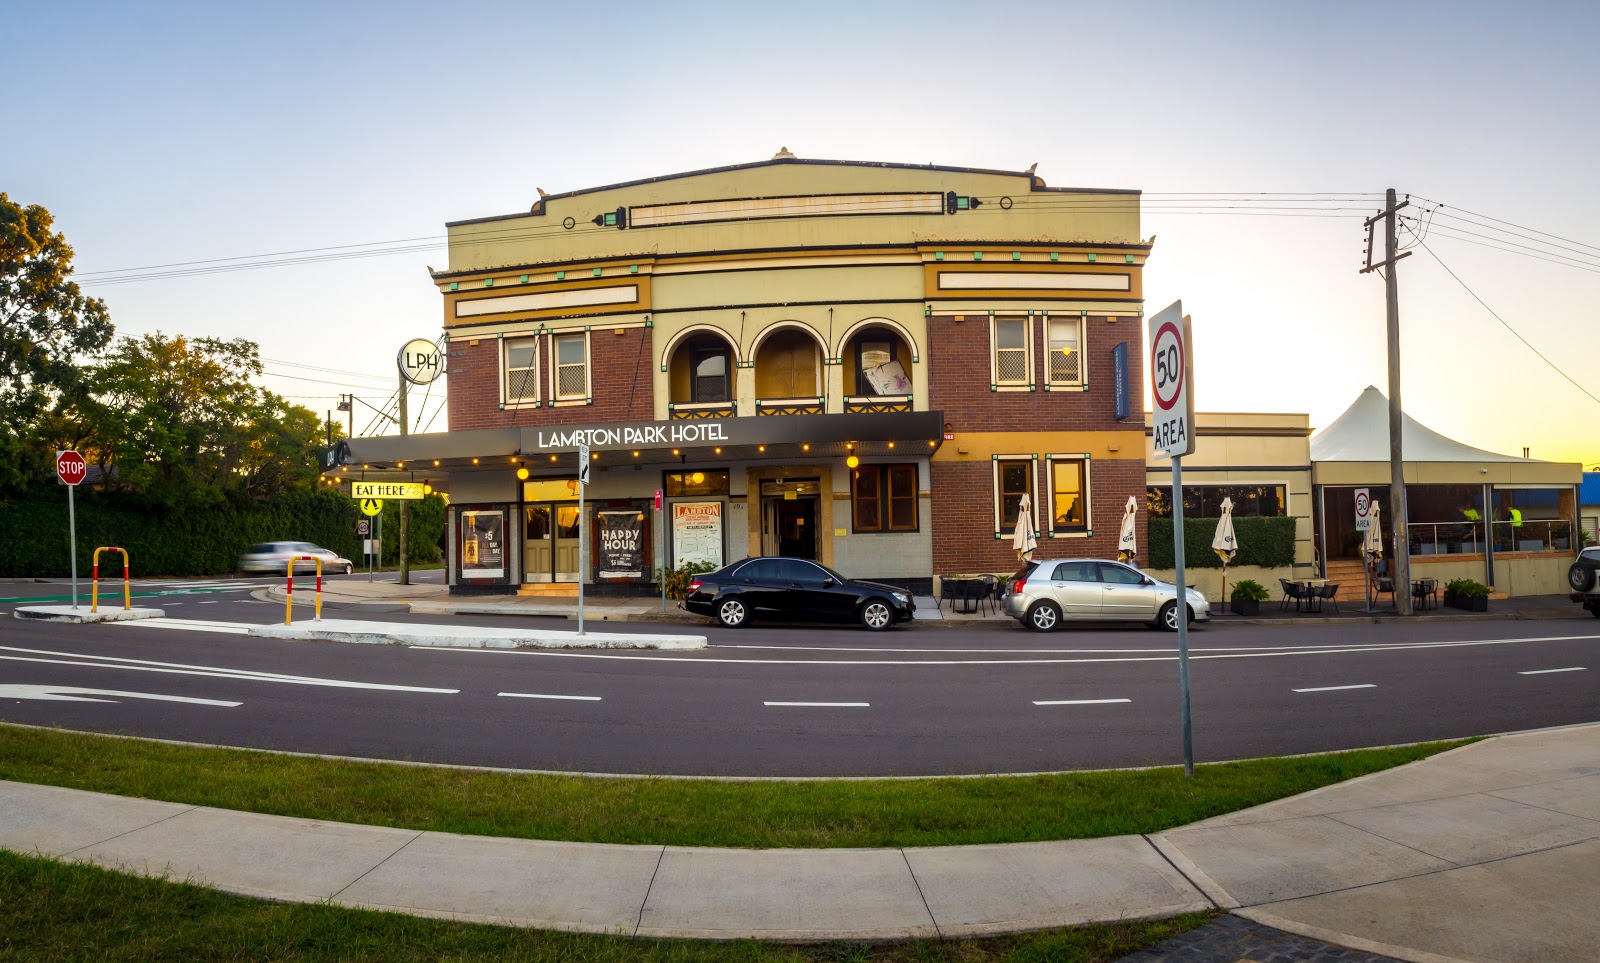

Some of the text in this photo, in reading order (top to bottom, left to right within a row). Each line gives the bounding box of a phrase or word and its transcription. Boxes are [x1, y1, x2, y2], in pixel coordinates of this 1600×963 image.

[406, 352, 438, 369] LPH
[1156, 344, 1179, 389] 50
[538, 423, 729, 448] LAMBTON PARK HOTEL
[1154, 416, 1186, 450] AREA
[59, 461, 84, 474] STOP
[356, 485, 405, 495] EAT HERE
[676, 504, 719, 518] LAMBTON
[1358, 499, 1367, 511] 50
[1356, 520, 1370, 528] AREA
[484, 530, 493, 541] $5
[601, 529, 640, 541] HAPPY
[604, 540, 636, 550] HOUR
